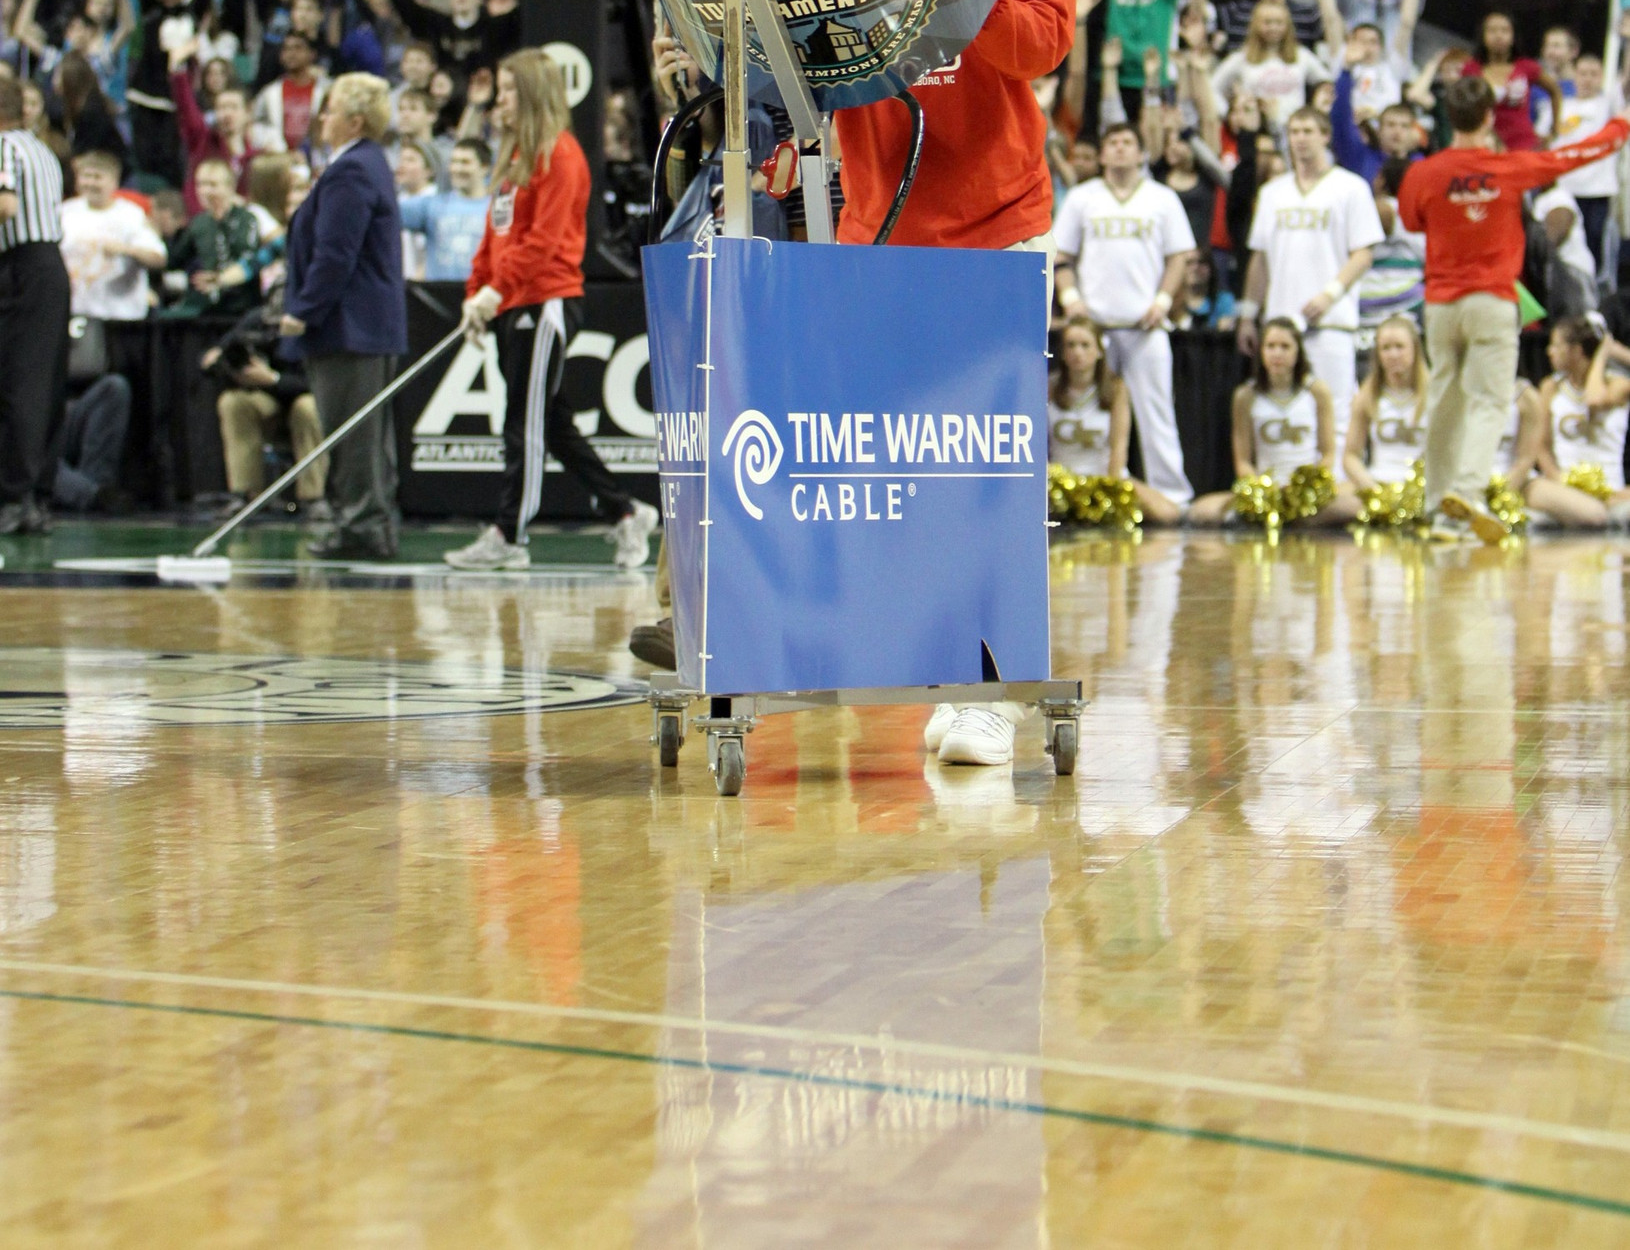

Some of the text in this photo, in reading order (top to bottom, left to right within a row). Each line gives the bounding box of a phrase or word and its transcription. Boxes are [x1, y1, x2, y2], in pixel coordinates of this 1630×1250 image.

[804, 56, 880, 77] AMPIONS
[881, 31, 906, 57] ARE
[943, 74, 955, 85] NC
[1091, 217, 1153, 239] TECH
[1275, 207, 1331, 230] TECH
[788, 412, 1035, 464] TIME WARNER
